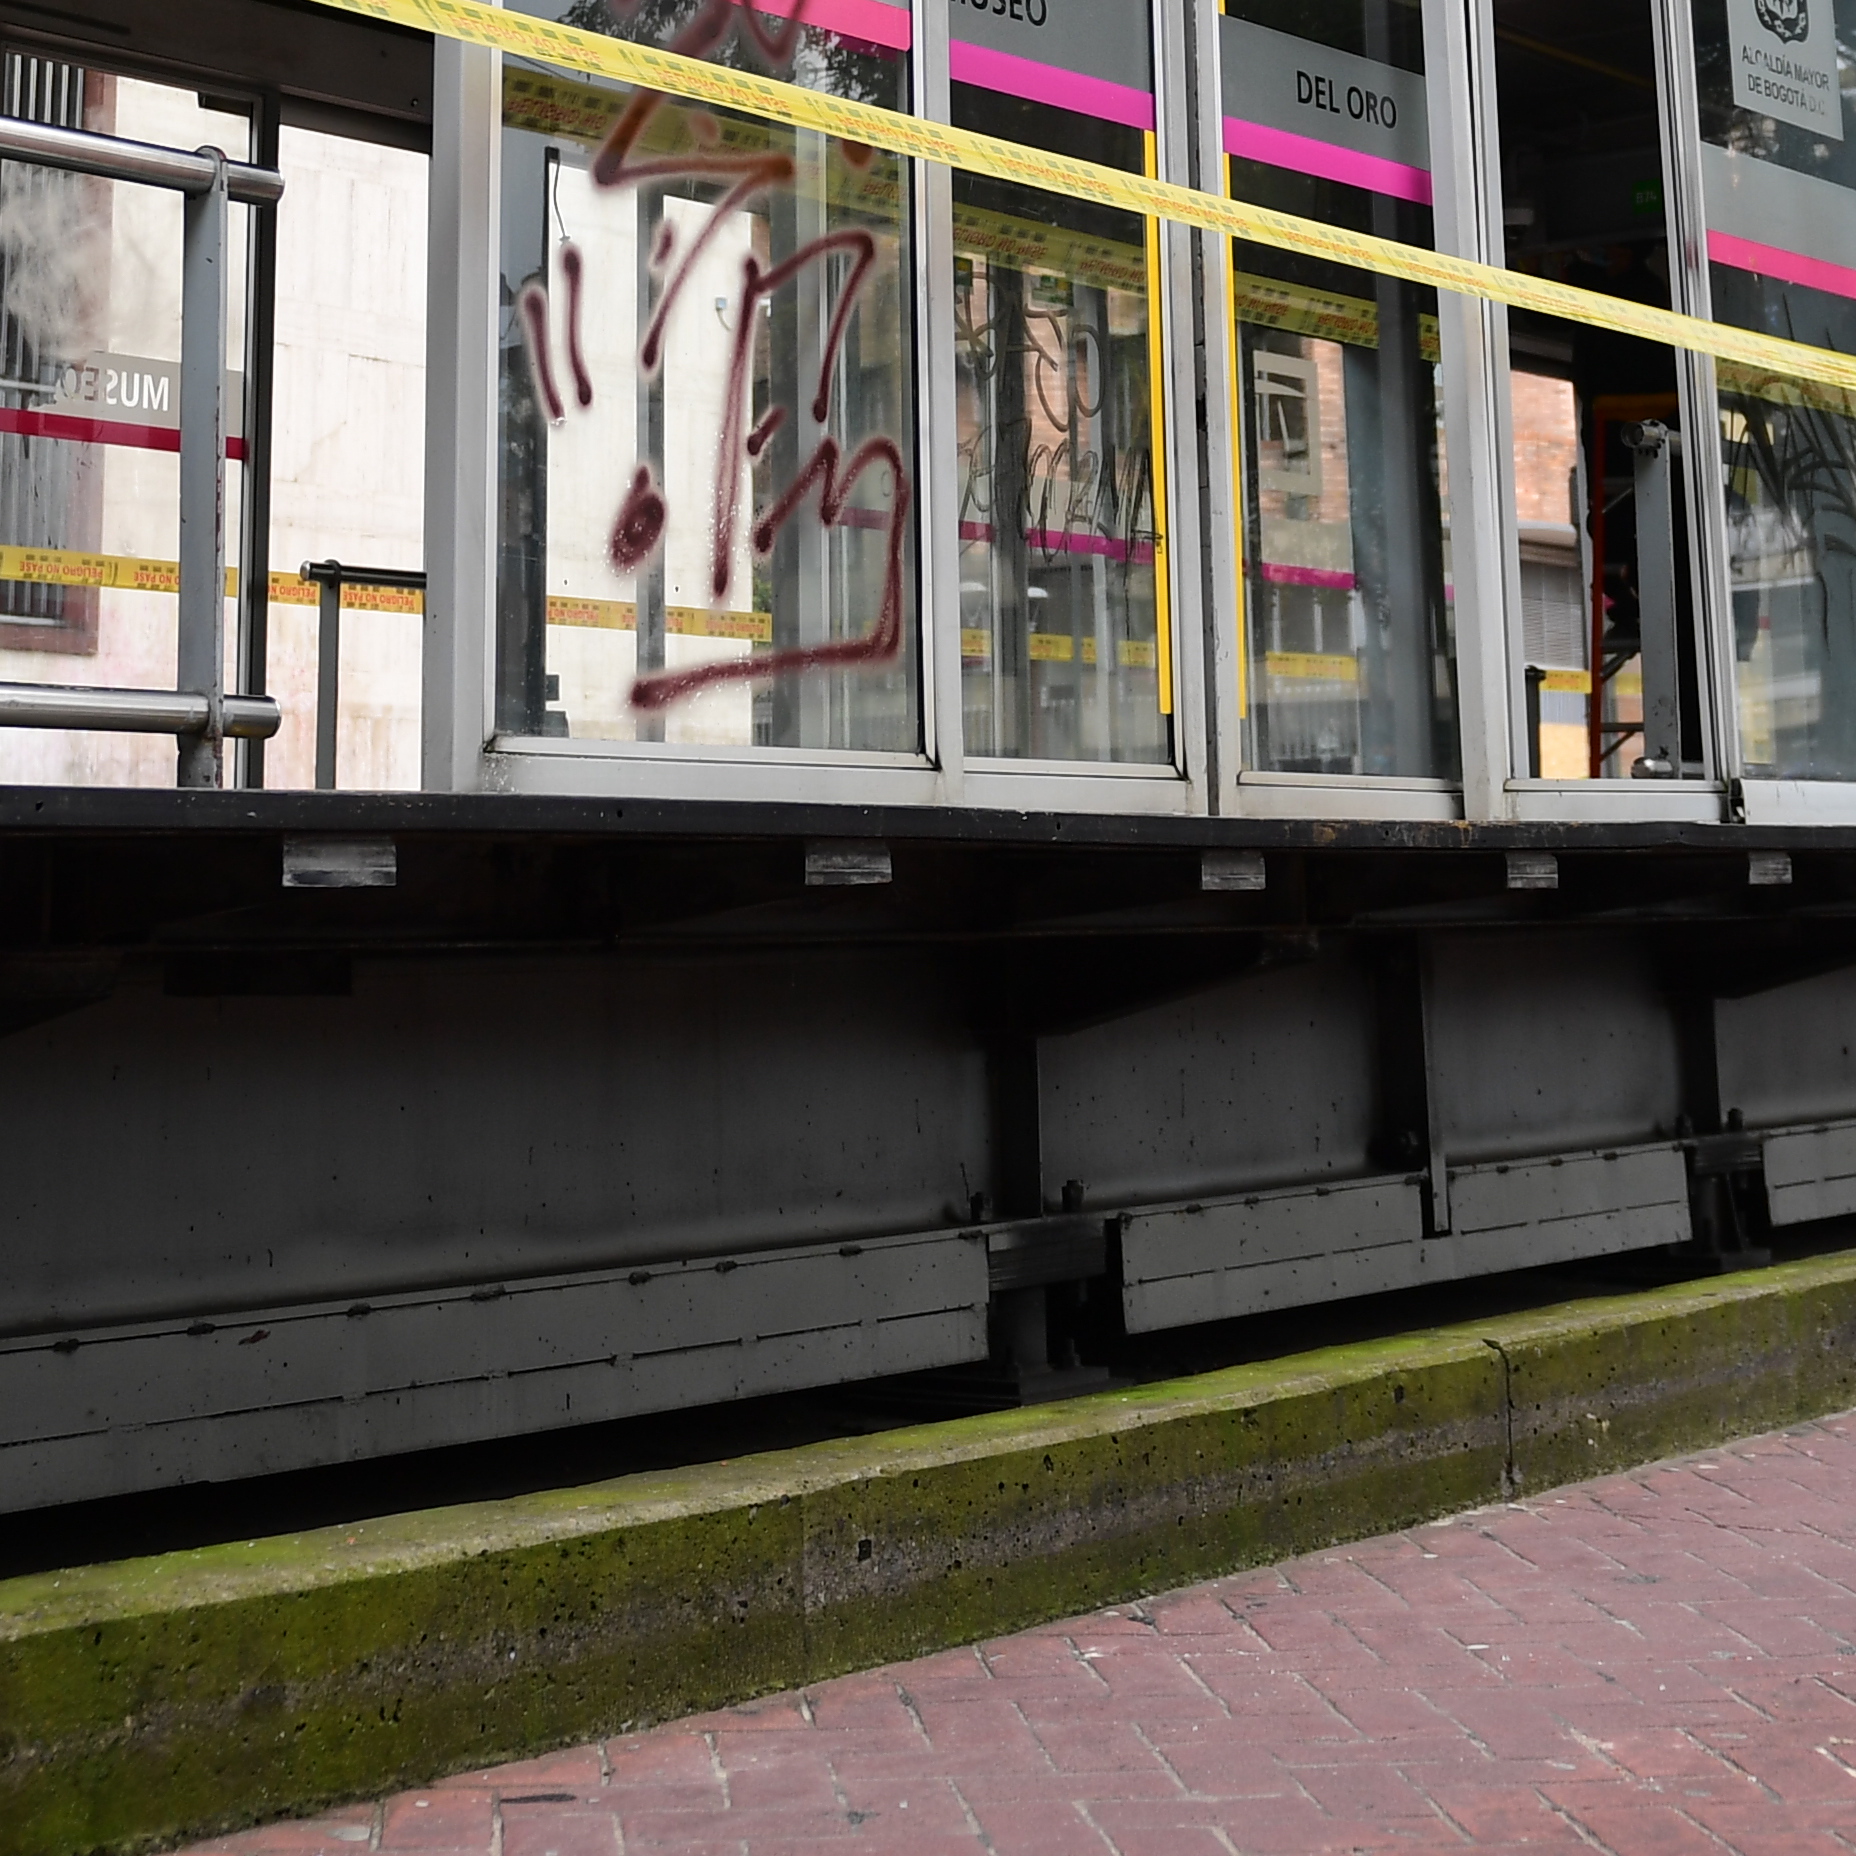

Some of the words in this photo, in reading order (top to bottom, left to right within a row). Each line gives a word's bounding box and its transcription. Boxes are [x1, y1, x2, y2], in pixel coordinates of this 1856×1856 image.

[1742, 44, 1793, 79] ALCALDÍA
[1794, 63, 1830, 91] MAYOR
[1747, 73, 1763, 95] DE
[1764, 79, 1808, 110] BOGOTÁ
[1296, 70, 1341, 114] DEL
[1347, 86, 1397, 129] ORO
[19, 560, 44, 573] PASE
[46, 564, 60, 575] NO
[62, 565, 104, 579] PELIGRO
[133, 571, 157, 583] PASE
[158, 573, 173, 585] NO
[365, 593, 378, 604] NO
[379, 594, 415, 607] PELIGRO
